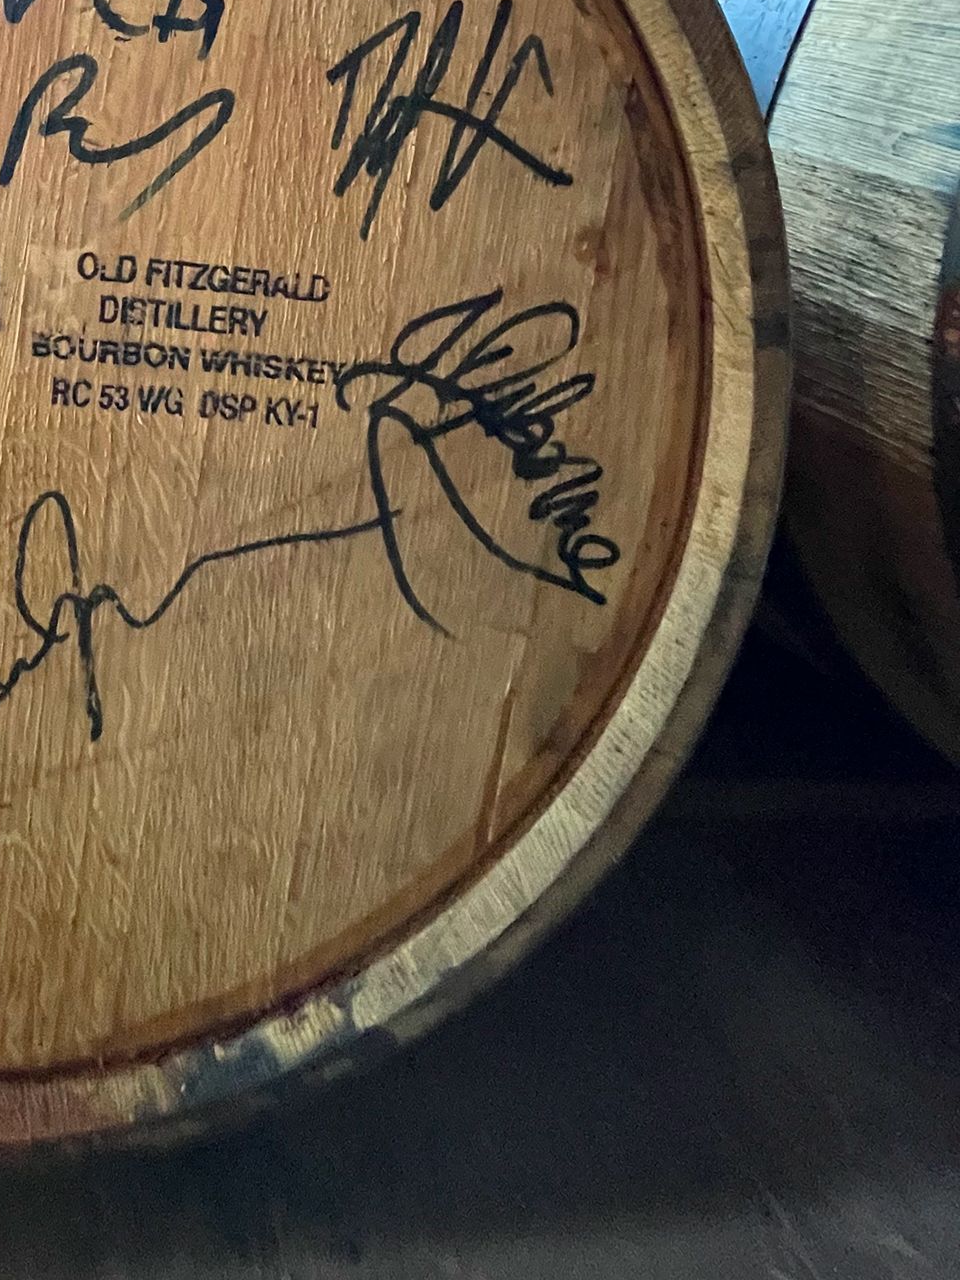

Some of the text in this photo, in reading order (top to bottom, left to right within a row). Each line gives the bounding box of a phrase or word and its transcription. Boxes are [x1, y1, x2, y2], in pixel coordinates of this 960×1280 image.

[145, 258, 330, 302] FITZGERALD
[99, 295, 269, 337] DISTILLERY
[31, 333, 346, 384] BOURBON WHISKEY
[51, 377, 320, 428] RC 53 WG DSP KY-1
